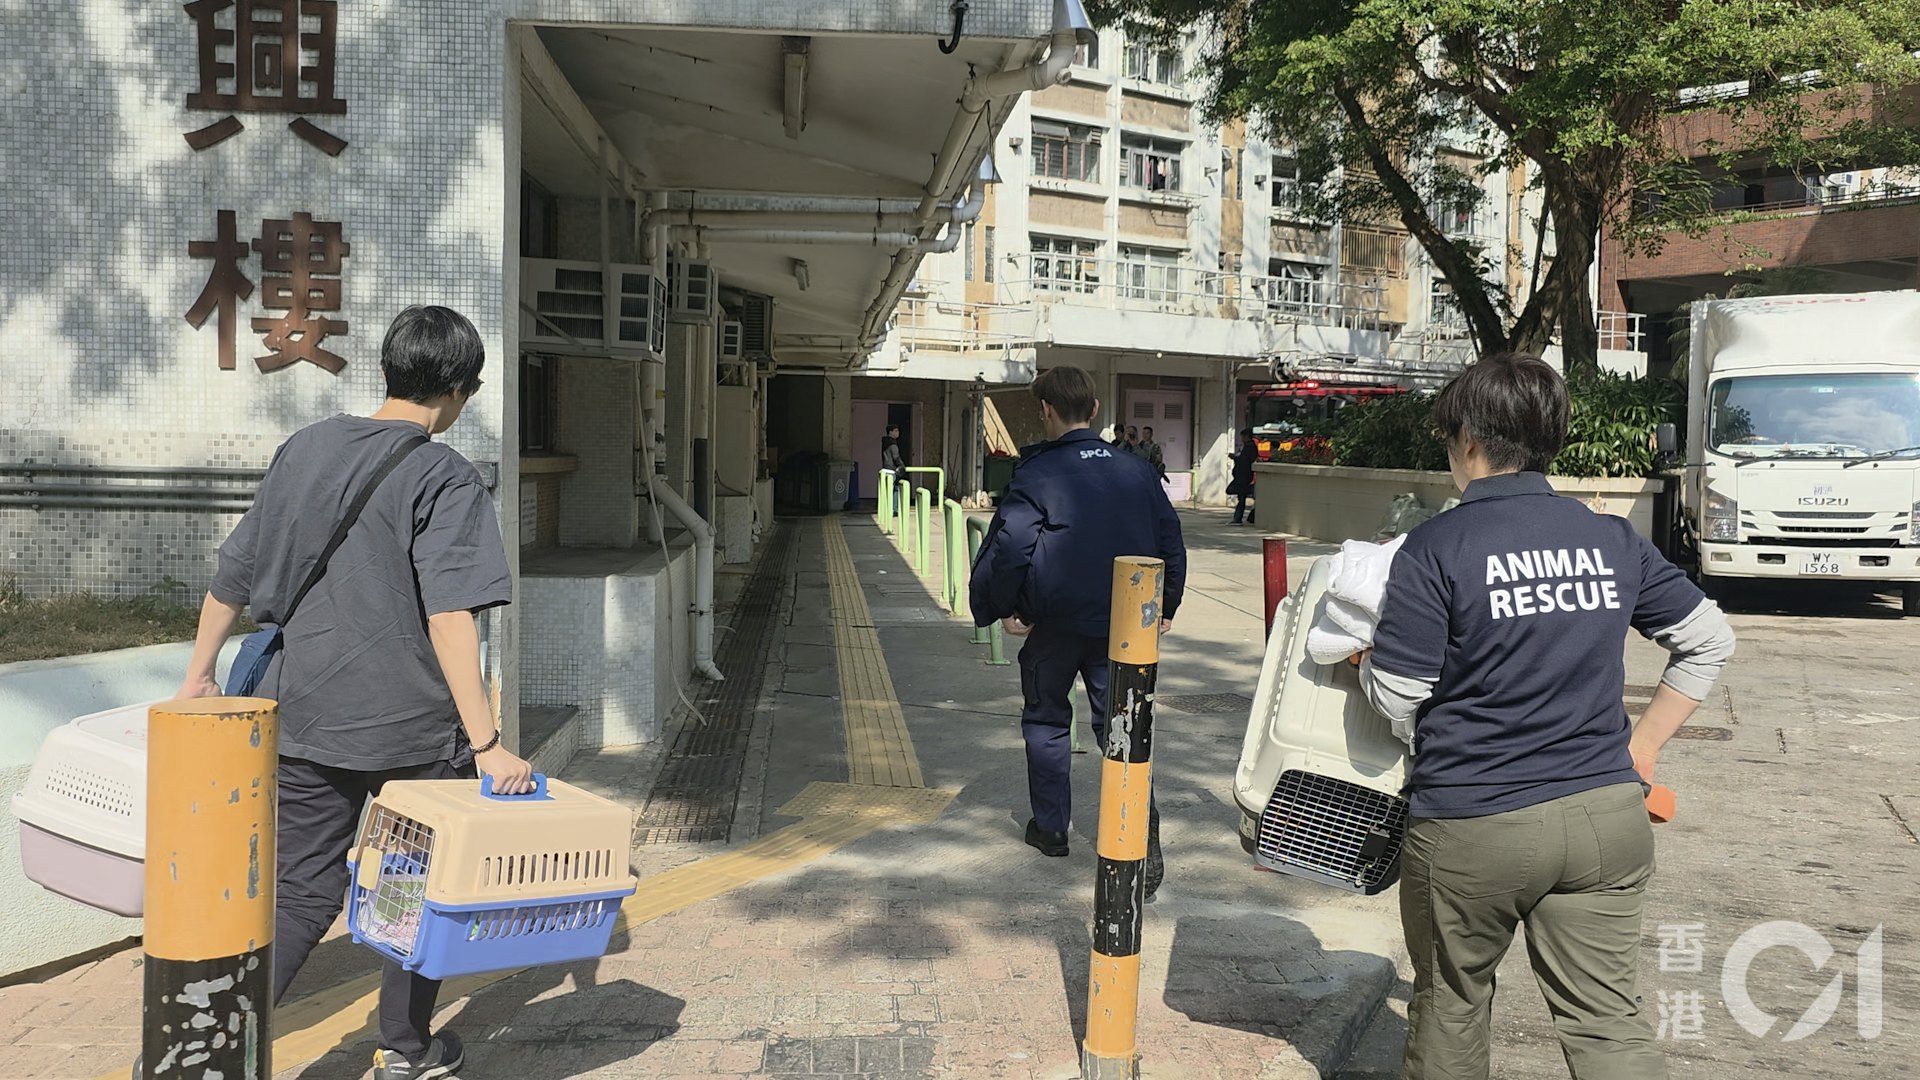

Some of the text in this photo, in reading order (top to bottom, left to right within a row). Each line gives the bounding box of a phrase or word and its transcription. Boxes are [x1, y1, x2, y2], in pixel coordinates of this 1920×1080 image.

[183, 0, 351, 376] 興樓
[1079, 448, 1113, 460] SPCA
[1798, 497, 1849, 506] ISUZU
[1812, 552, 1831, 563] WY
[1486, 548, 1615, 585] ANIMAL
[1805, 563, 1839, 574] 1568
[1489, 581, 1621, 620] RESCUE
